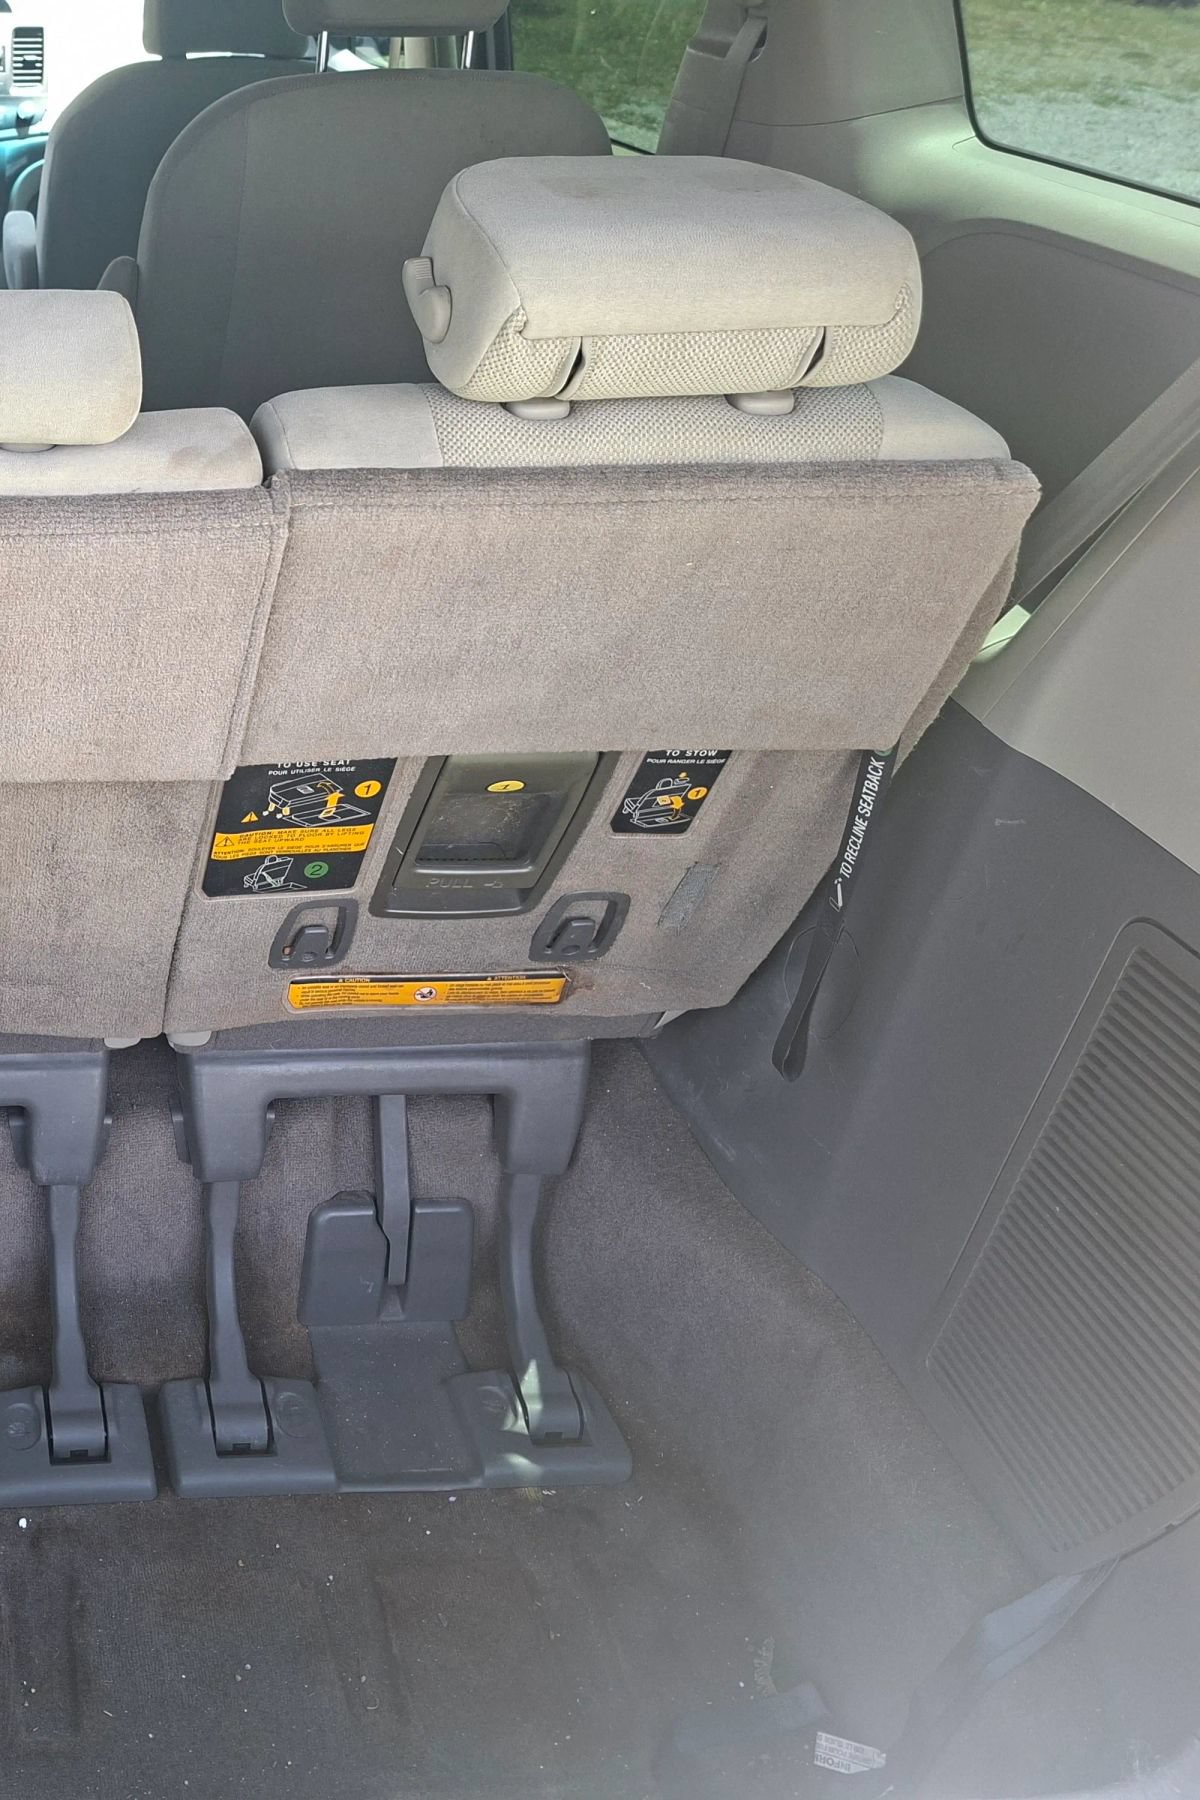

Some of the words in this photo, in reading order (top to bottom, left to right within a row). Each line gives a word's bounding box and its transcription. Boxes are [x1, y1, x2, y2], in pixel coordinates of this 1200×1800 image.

[290, 767, 321, 775] UTILISER
[857, 756, 886, 818] SEATBACK
[844, 814, 868, 866] RECLINE
[309, 864, 323, 876] 2
[839, 862, 853, 879] TO
[424, 877, 474, 889] PULL
